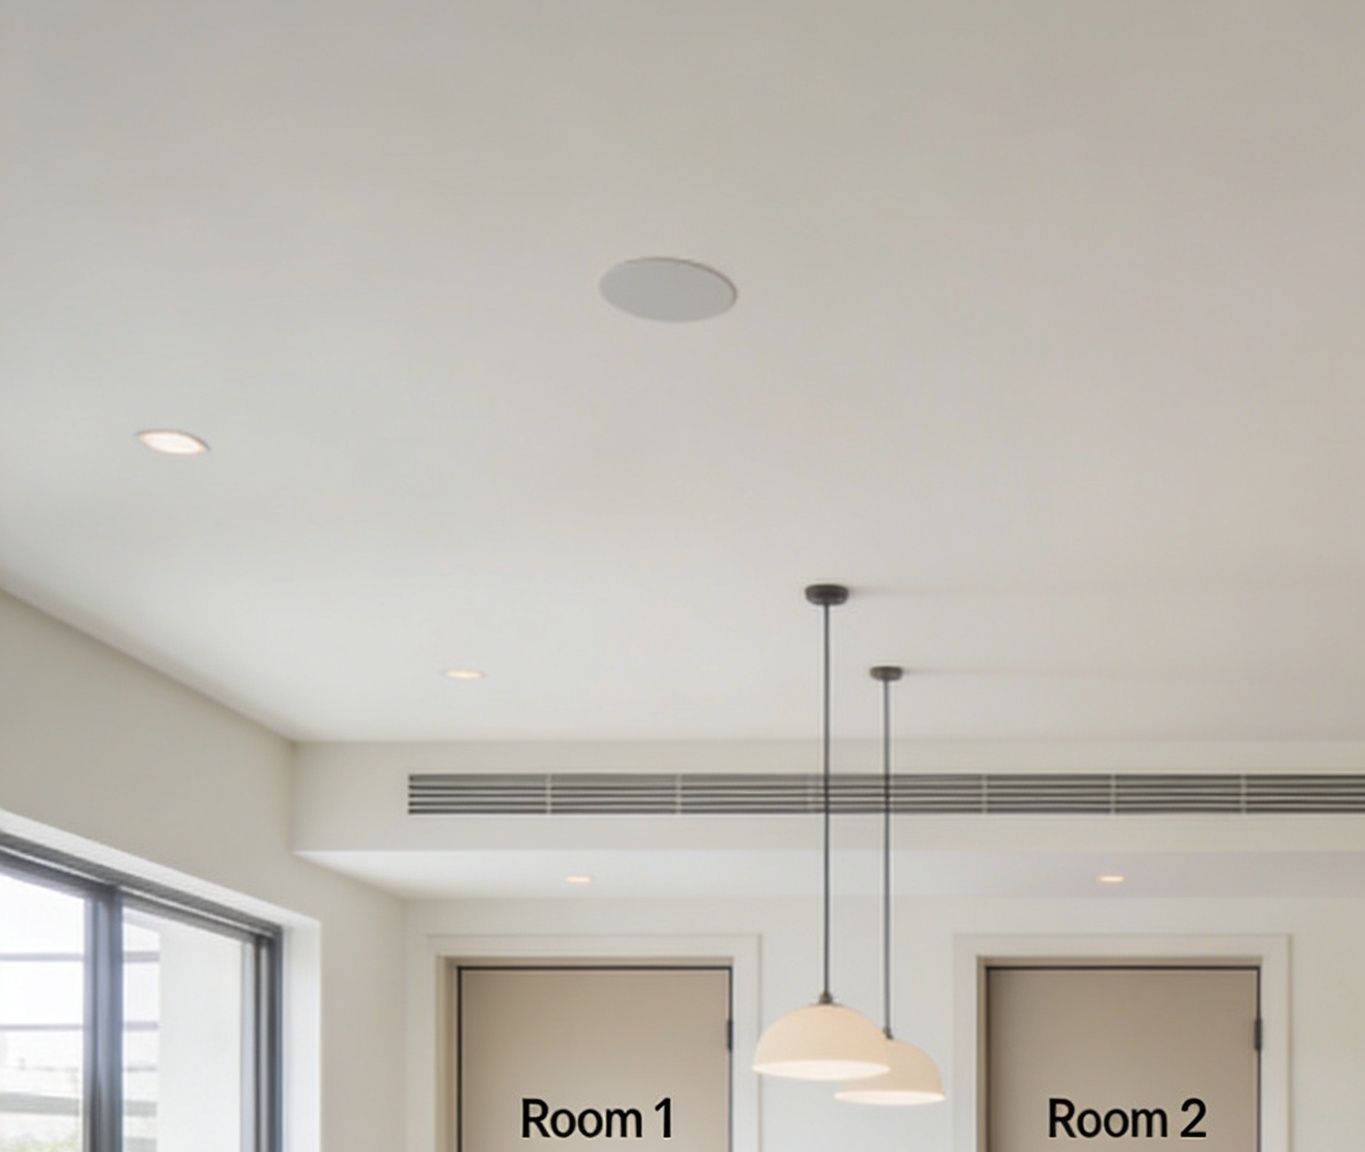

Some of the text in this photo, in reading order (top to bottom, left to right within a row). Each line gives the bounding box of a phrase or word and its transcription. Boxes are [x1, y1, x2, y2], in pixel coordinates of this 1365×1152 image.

[523, 1097, 671, 1138] Room 1
[1050, 1097, 1207, 1138] Room 2
